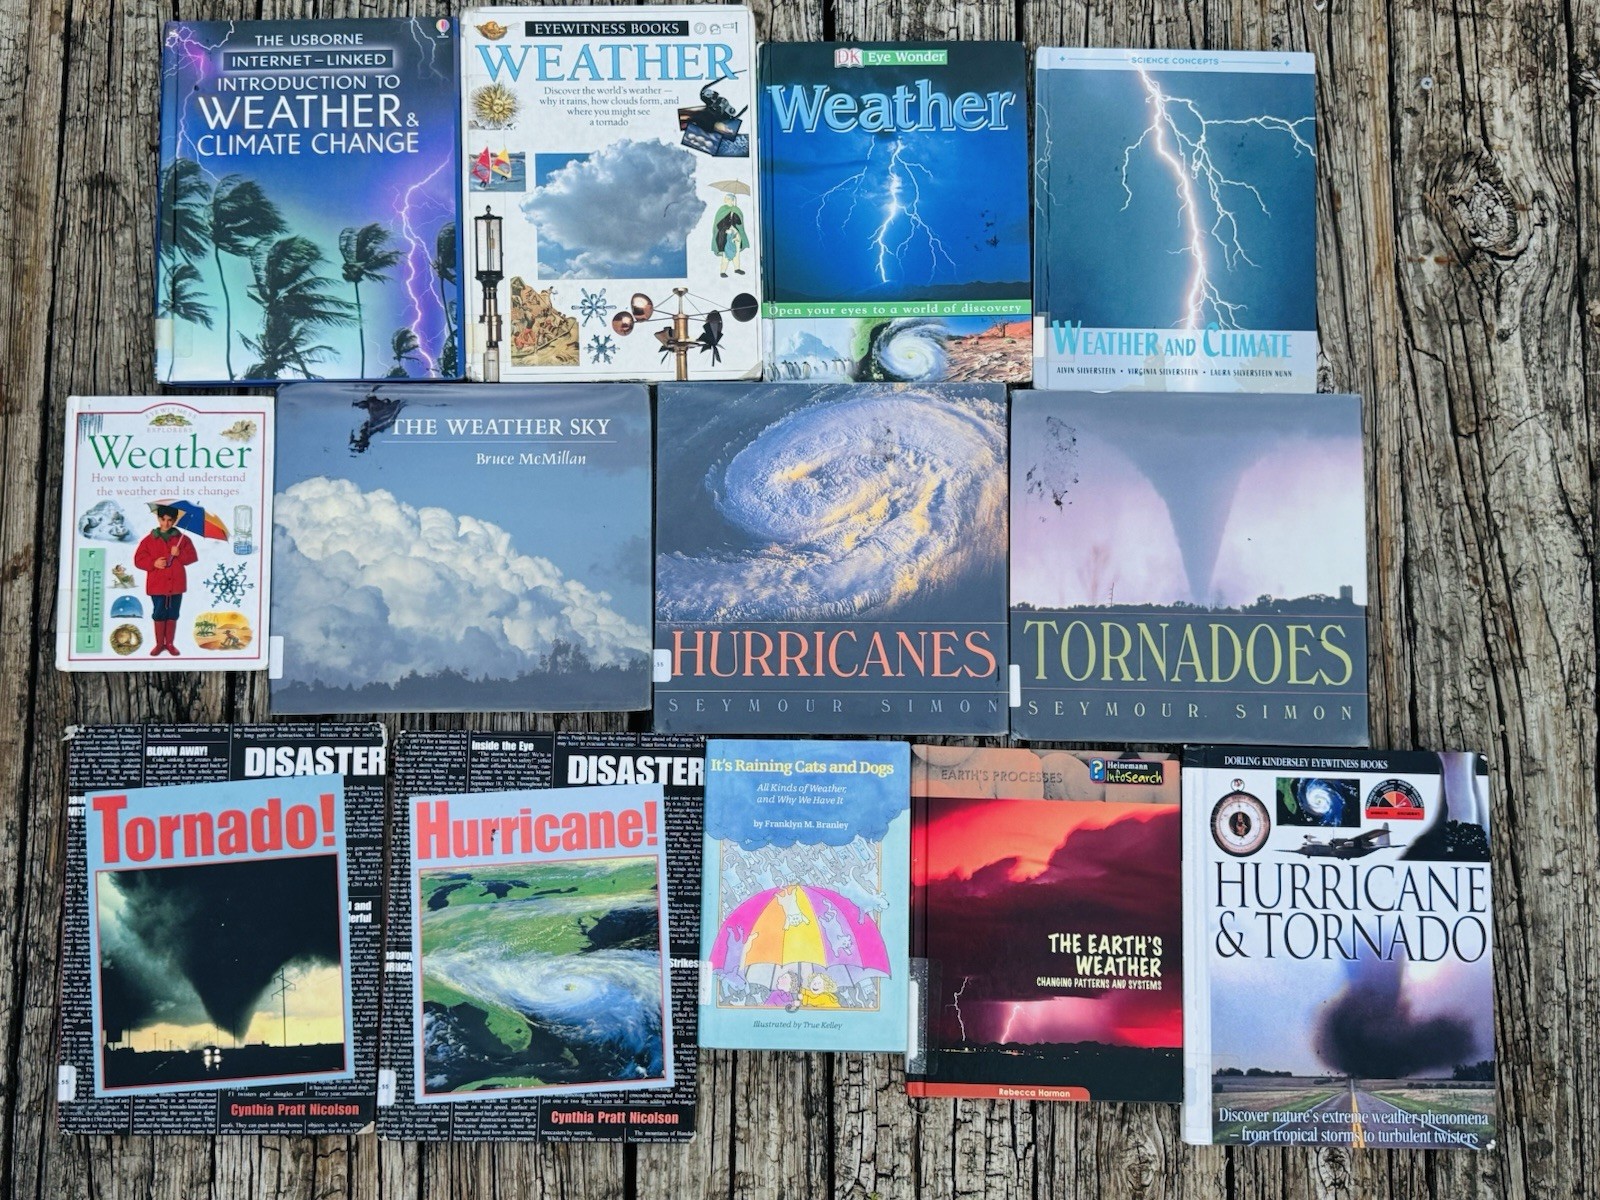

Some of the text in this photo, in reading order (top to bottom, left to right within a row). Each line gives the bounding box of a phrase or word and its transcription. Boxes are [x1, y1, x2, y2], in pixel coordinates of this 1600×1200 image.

[535, 23, 679, 35] EYEWITNESS BOOKS
[255, 34, 363, 46] THE USBORNE
[475, 43, 739, 82] WEATHER
[838, 50, 944, 65] DK Eye Wonder
[218, 75, 400, 90] INTRODUCTION TO
[544, 86, 662, 95] Discover the world's weather
[539, 97, 556, 106] why
[567, 97, 589, 106] rains,
[591, 96, 609, 104] how
[611, 96, 638, 104] clouds
[639, 96, 663, 106] form,
[664, 96, 679, 104] and
[766, 79, 1016, 133] Weather
[198, 94, 419, 130] WEATHER &
[567, 107, 592, 115] where
[594, 108, 610, 117] you
[612, 107, 635, 117] might
[596, 118, 628, 126] tornado
[197, 132, 419, 156] CLIMATE CHANGE
[769, 306, 801, 316] Open
[807, 308, 835, 317] your
[841, 307, 867, 316] eyes
[873, 305, 885, 314] to
[903, 304, 937, 314] world
[944, 304, 956, 313] of
[961, 304, 1021, 314] discovery
[1164, 339, 1196, 356] AND
[1077, 367, 1116, 375] SILVERSTEIN
[391, 418, 611, 436] THE WEATHER SKY
[89, 433, 252, 469] Weather
[476, 450, 586, 465] Bruce McMillan
[91, 473, 246, 482] How to watch and understand
[97, 486, 239, 497] the weather and its changes
[671, 630, 997, 678] HURRICANES
[1023, 620, 1353, 686] TORNADOES
[669, 699, 999, 713] SEYMOUR SIMON
[1028, 700, 1352, 720] SEYMOUR SIMON
[146, 746, 208, 756] BLOWN AWAY!
[472, 741, 534, 752] Inside the Eye
[245, 747, 386, 777] DISASTER
[711, 759, 894, 778] It's Raining Cats and Dogs
[1107, 762, 1148, 770] Heinemann
[1224, 756, 1388, 769] DORLING KINDERSLEY EYEWITNESS BOOKS
[568, 755, 704, 786] DISASTER
[941, 770, 1062, 783] EARTH'S PROCESSES
[757, 784, 847, 793] All Kinds of Weather,
[778, 796, 797, 805] Why
[92, 794, 336, 863] Tornado!
[416, 801, 658, 860] Hurricane!
[753, 820, 763, 829] by
[765, 821, 802, 829] Franklyn
[816, 821, 849, 830] Branley
[1215, 862, 1486, 913] HURRICANE
[354, 901, 371, 911] and
[1216, 911, 1487, 962] & TORNADO
[1048, 933, 1162, 956] THE EARTH'S
[670, 958, 699, 968] Strikes
[1076, 955, 1162, 977] WEATHER
[1037, 977, 1162, 990] CHANGING PATTERNS AND SYSTEMS
[793, 1021, 801, 1029] by
[821, 1022, 843, 1030] Kelley
[999, 1088, 1070, 1097] Rebecca Harman
[231, 1104, 359, 1117] Cynthia Pratt Nicolson
[1219, 1108, 1489, 1126] Discover nature's extreme weather phenomena
[551, 1111, 679, 1124] Cynthia Pratt Nicolson
[1242, 1126, 1479, 1145] from tropical storms to turbulent twisters
